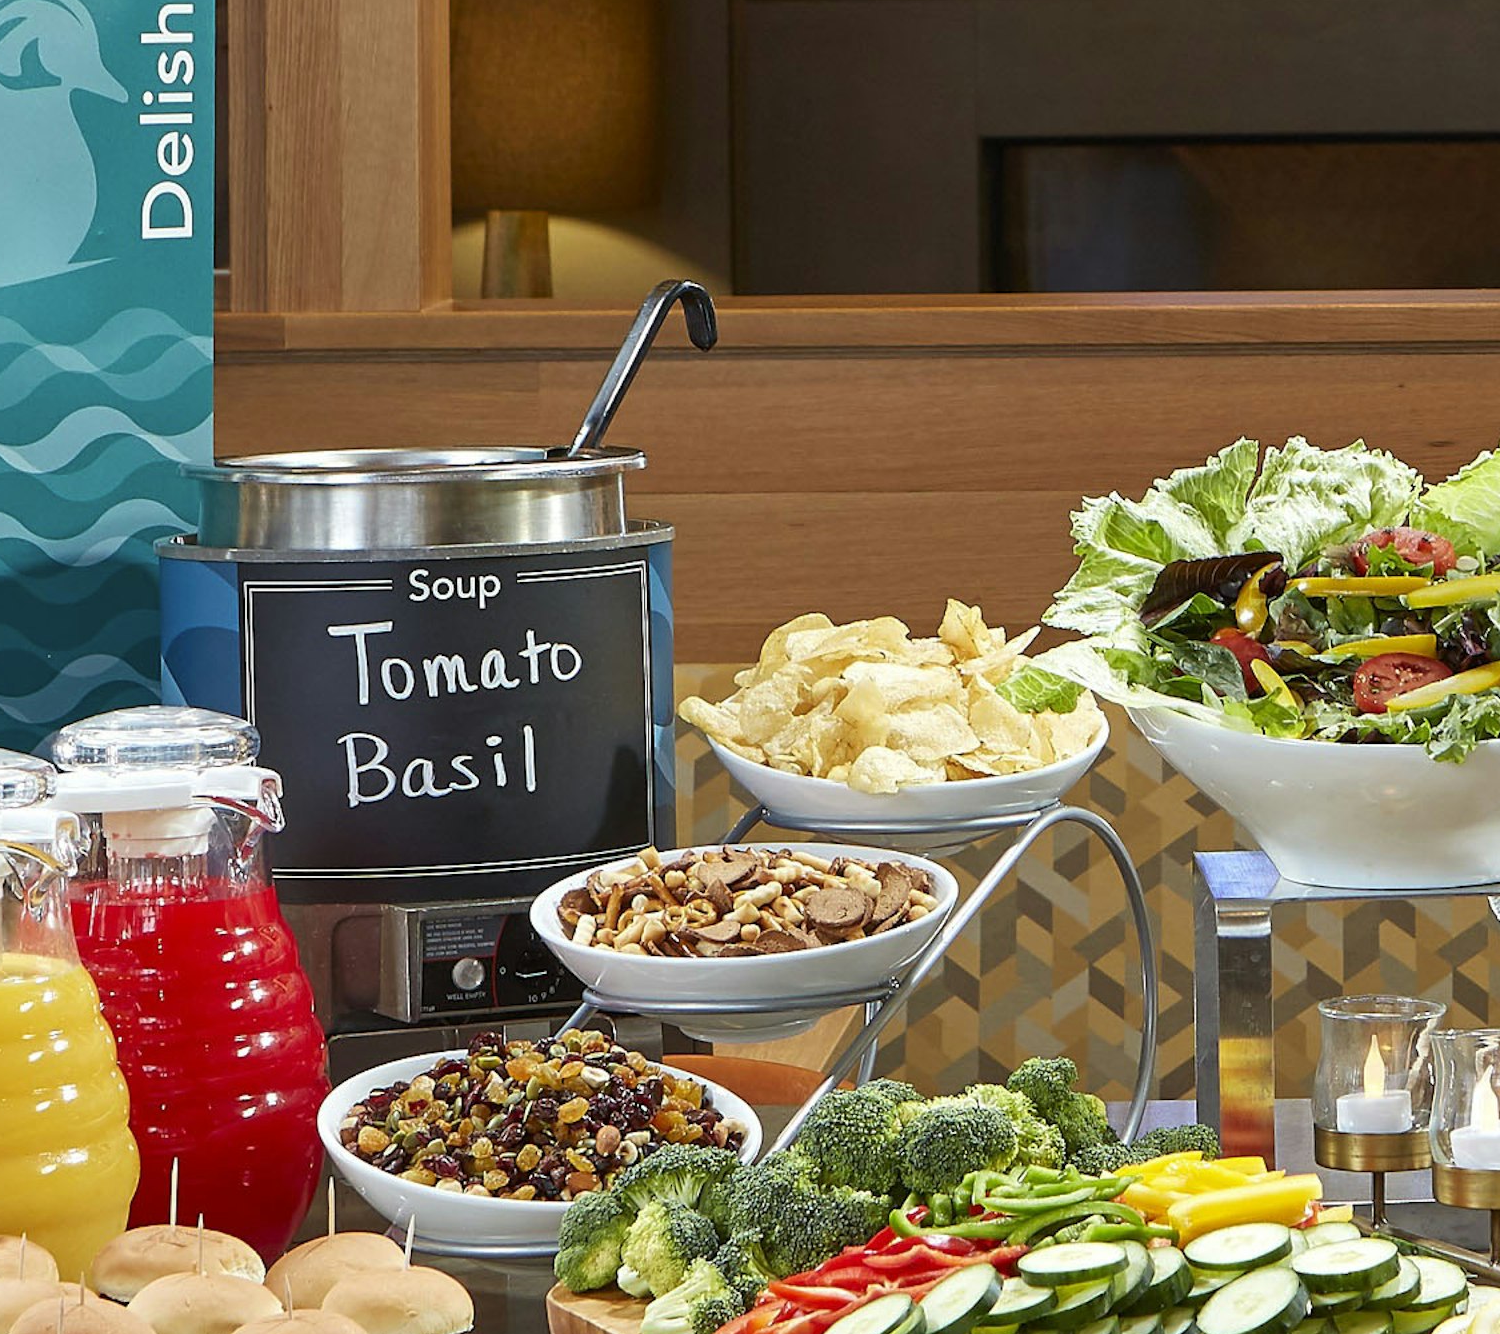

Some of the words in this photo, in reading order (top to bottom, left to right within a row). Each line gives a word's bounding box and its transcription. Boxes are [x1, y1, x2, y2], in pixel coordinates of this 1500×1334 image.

[140, 3, 195, 239] Delish
[409, 568, 501, 609] Soup
[327, 620, 582, 705] Tomato
[337, 725, 536, 807] Basil
